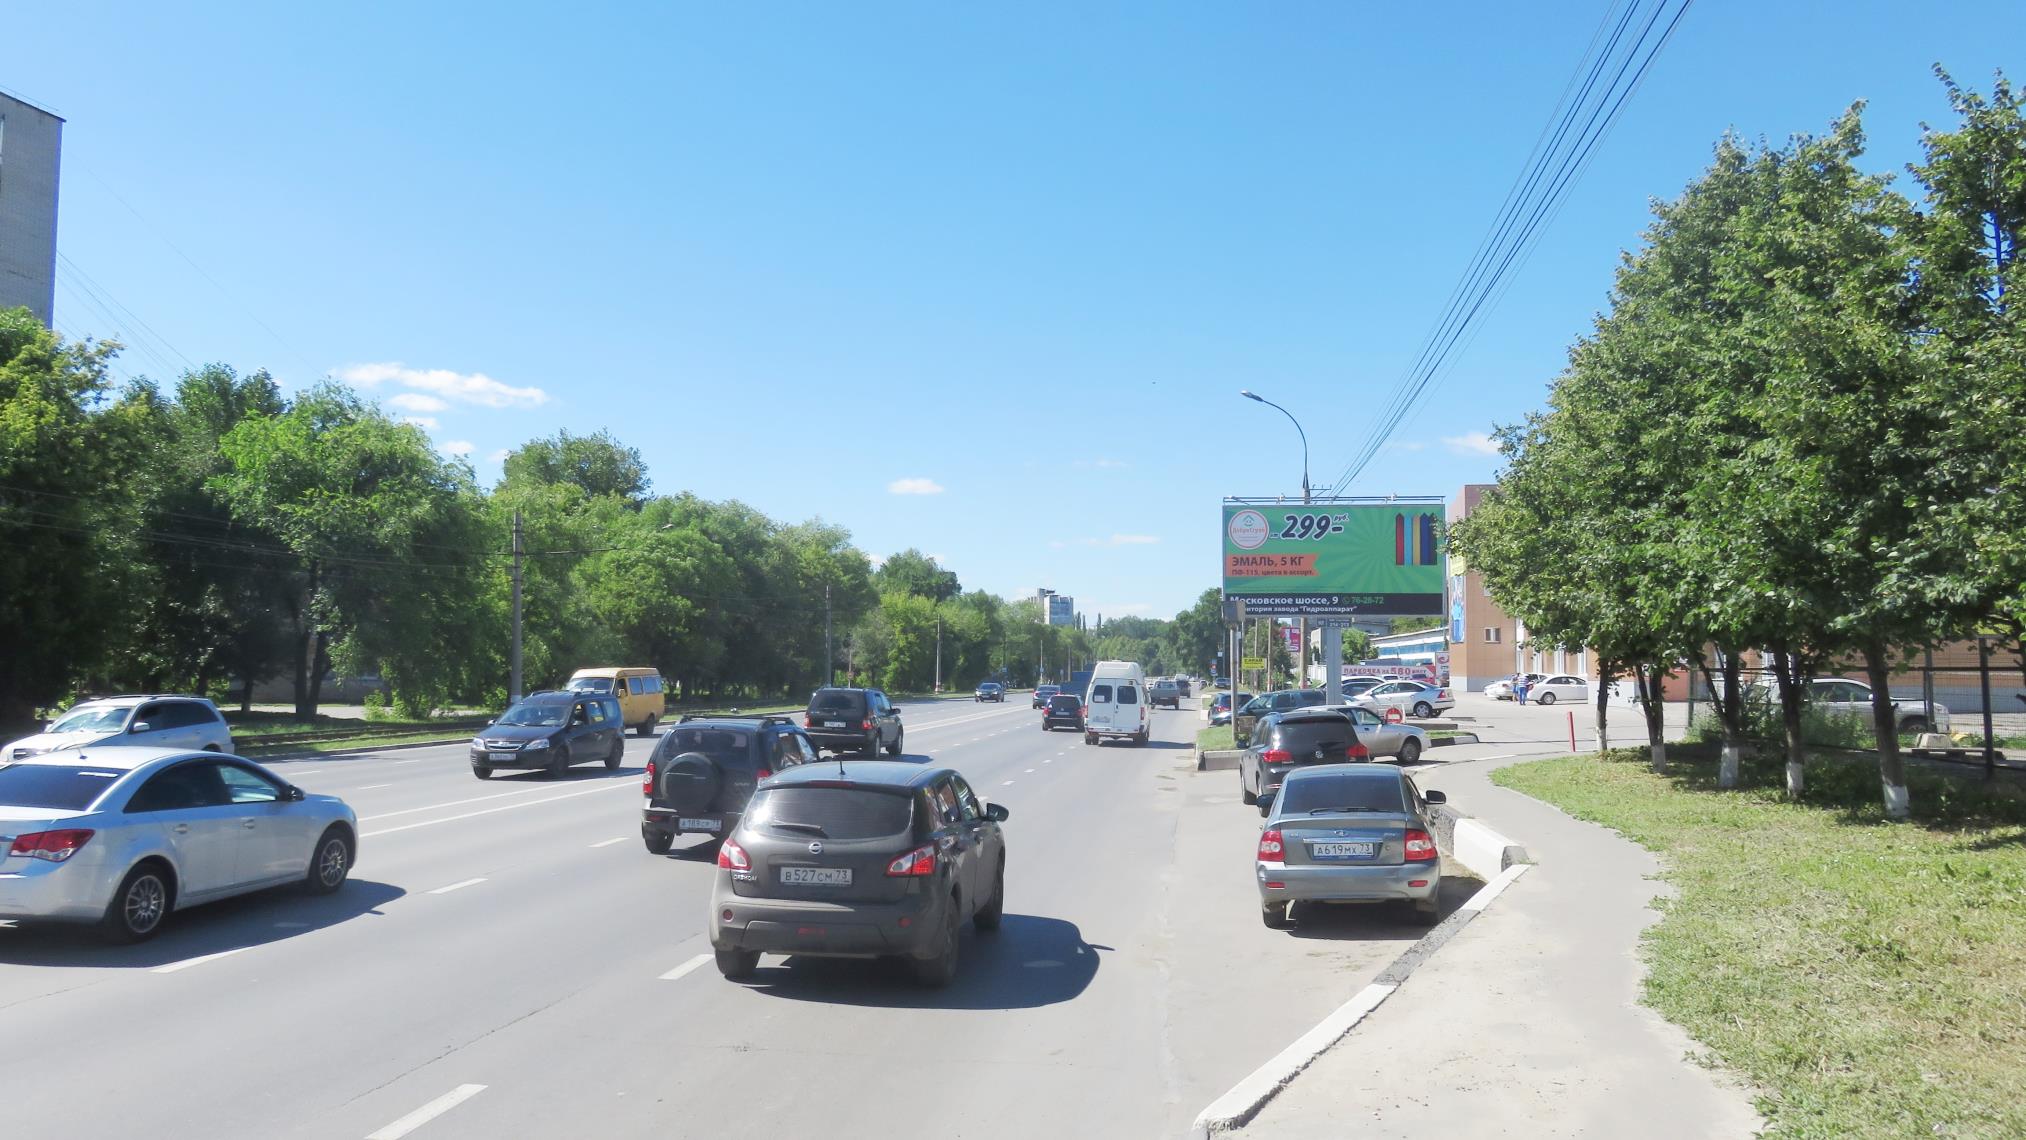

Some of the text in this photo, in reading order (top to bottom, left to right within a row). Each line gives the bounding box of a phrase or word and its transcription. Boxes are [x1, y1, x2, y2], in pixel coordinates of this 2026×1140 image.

[1231, 556, 1305, 567] ЭМАЛЬ, 5 КГ
[1295, 597, 1330, 606] шоссе,
[1332, 596, 1339, 605] 9
[1343, 667, 1380, 675] ПАРКОВКА
[1390, 667, 1411, 676] 580
